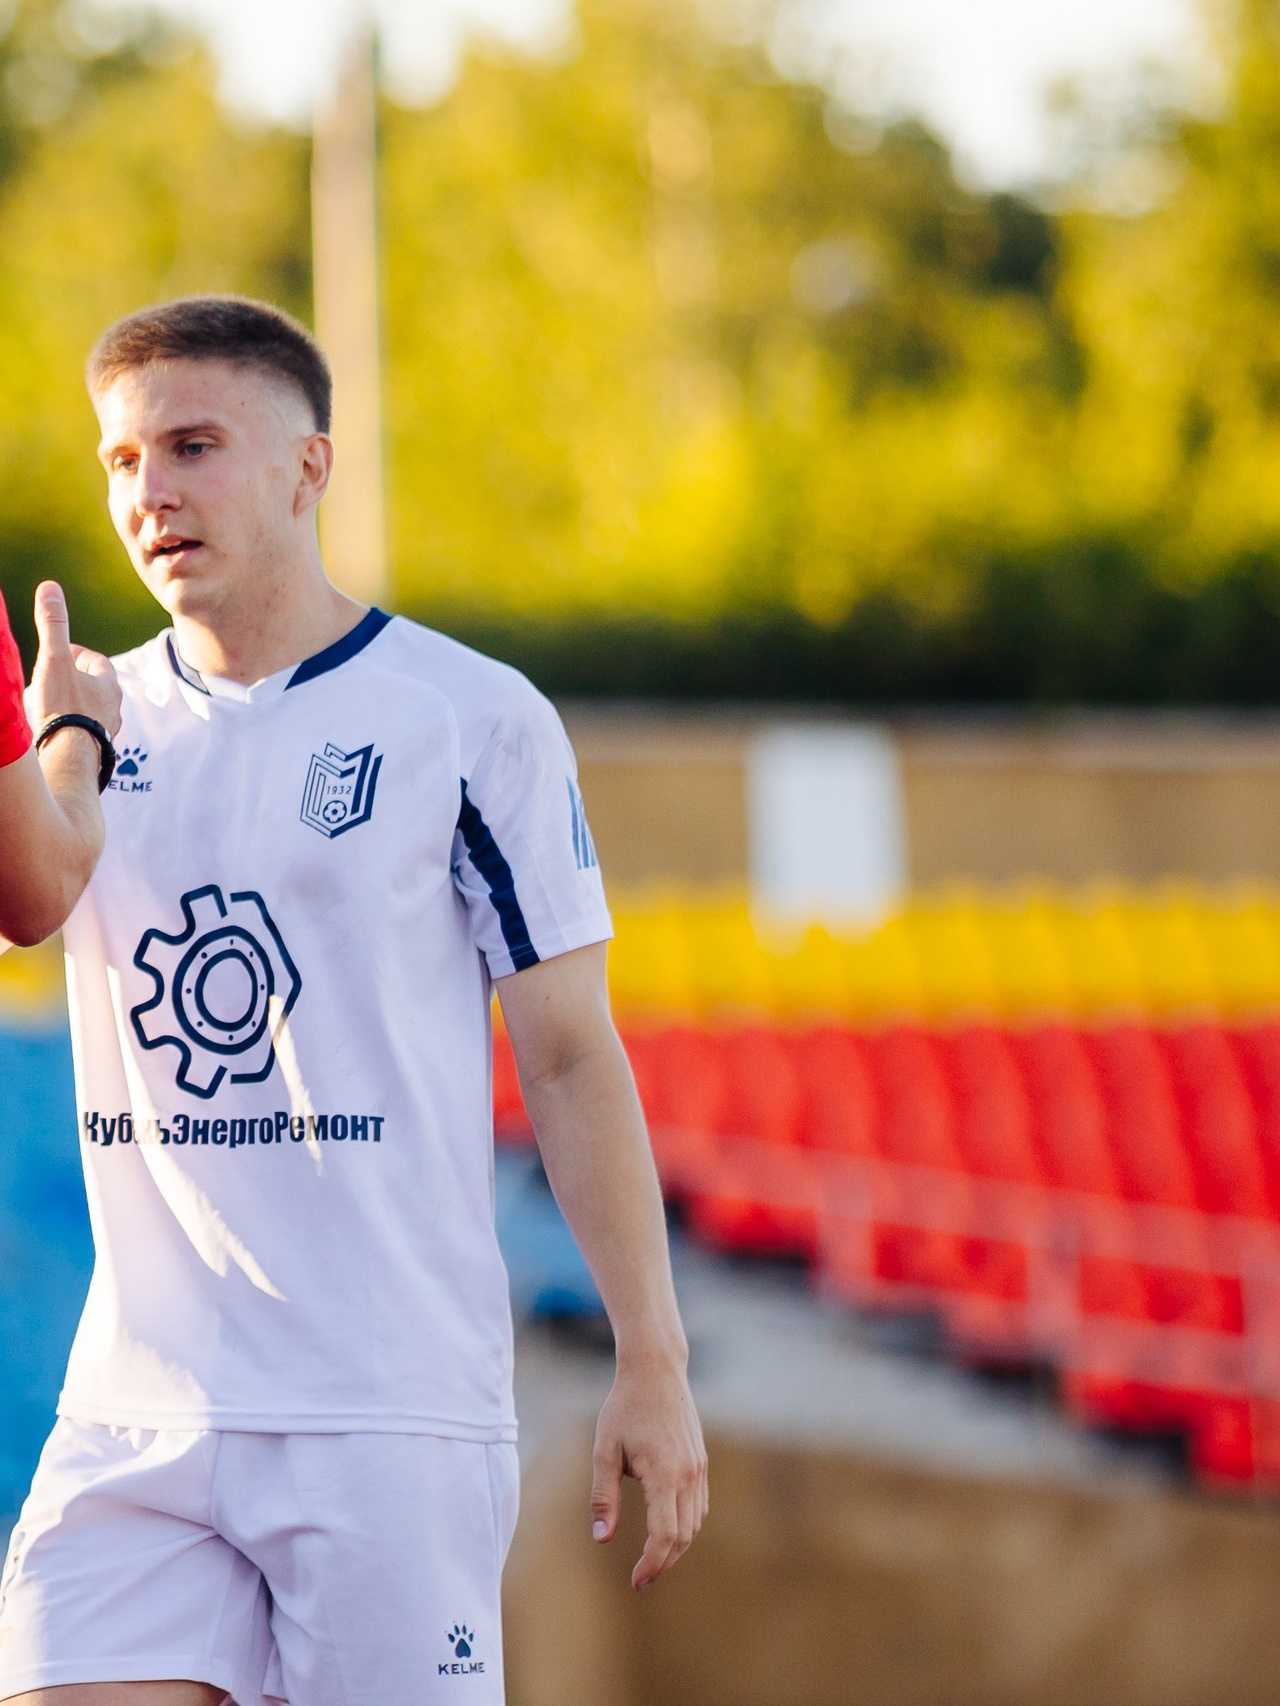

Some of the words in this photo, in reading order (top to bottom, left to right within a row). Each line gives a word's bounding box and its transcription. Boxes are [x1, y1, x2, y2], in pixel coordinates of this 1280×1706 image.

[108, 780, 153, 793] ELME
[326, 785, 352, 795] 1932
[84, 1111, 385, 1149] КубьЭнергоРемонт
[438, 1662, 485, 1675] KELME
